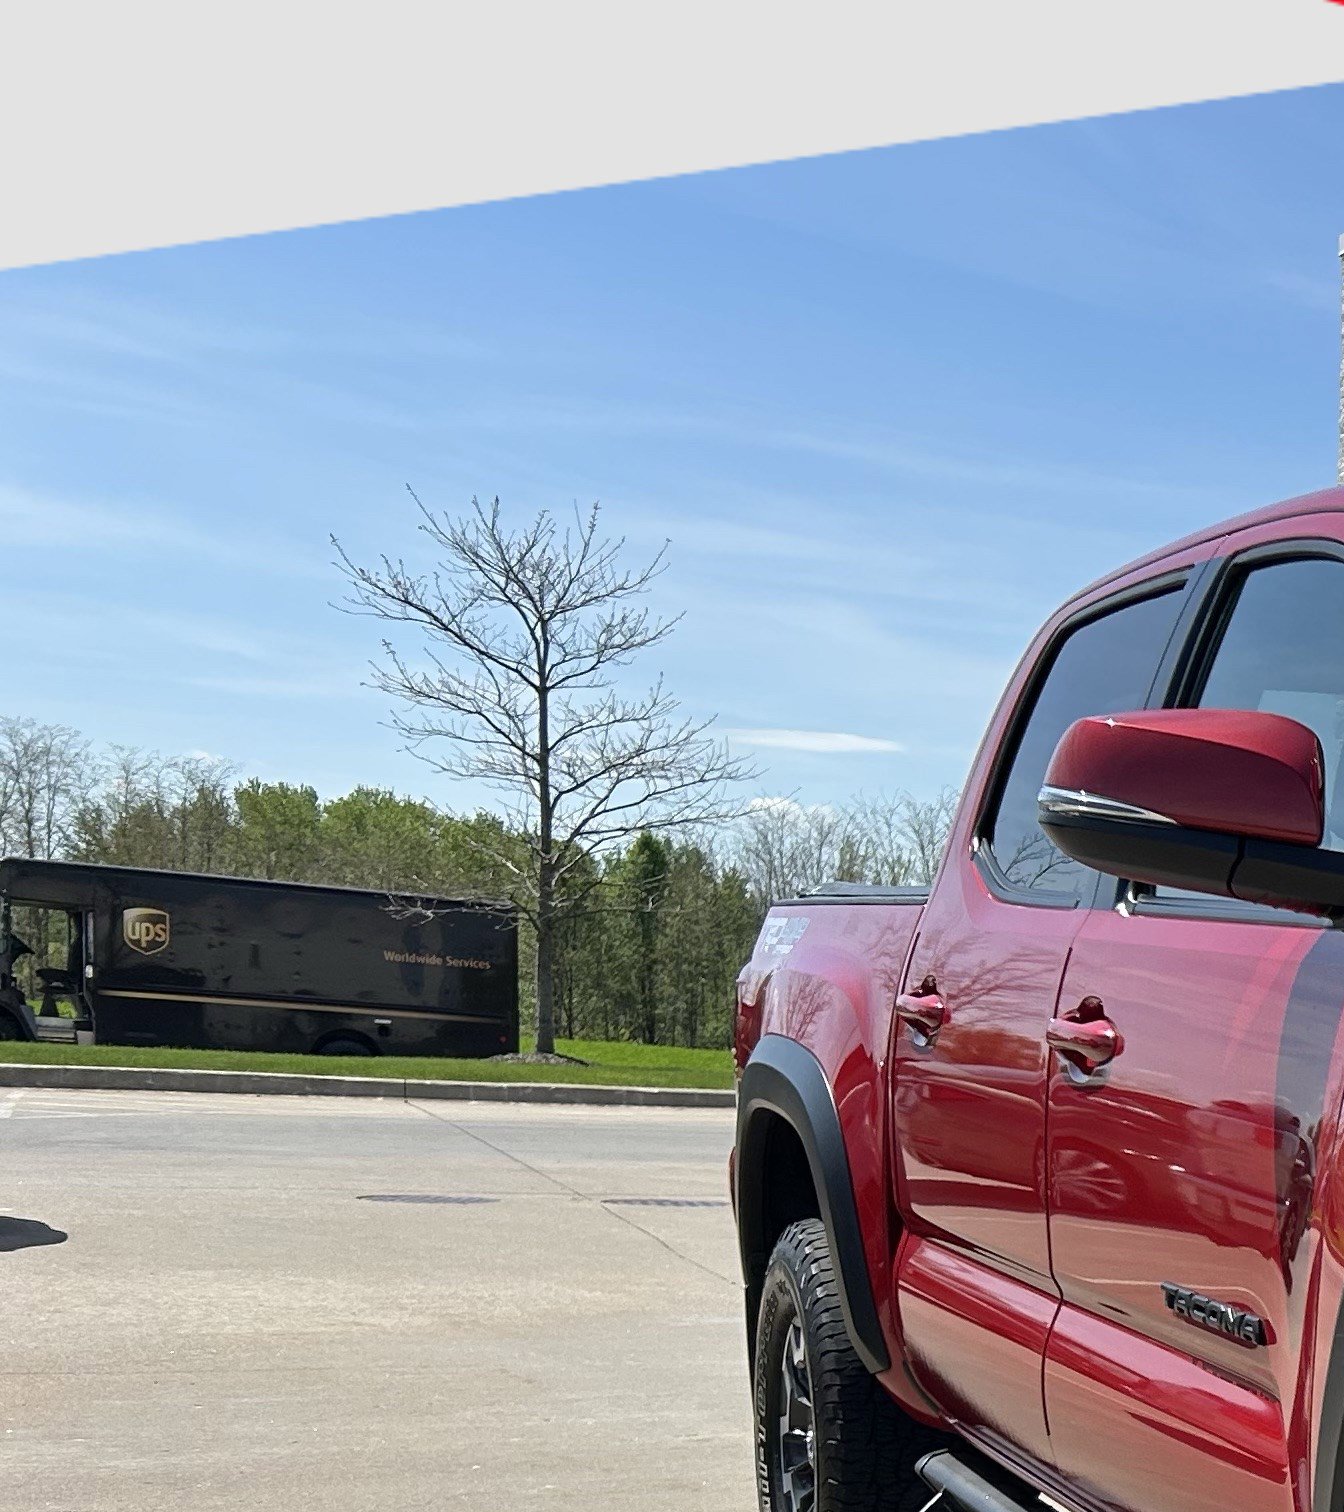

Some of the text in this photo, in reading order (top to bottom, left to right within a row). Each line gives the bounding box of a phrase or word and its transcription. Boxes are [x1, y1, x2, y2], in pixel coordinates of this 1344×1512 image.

[127, 920, 167, 948] ups
[383, 949, 492, 970] Worldwide Services
[1160, 1280, 1266, 1346] TACOMA
